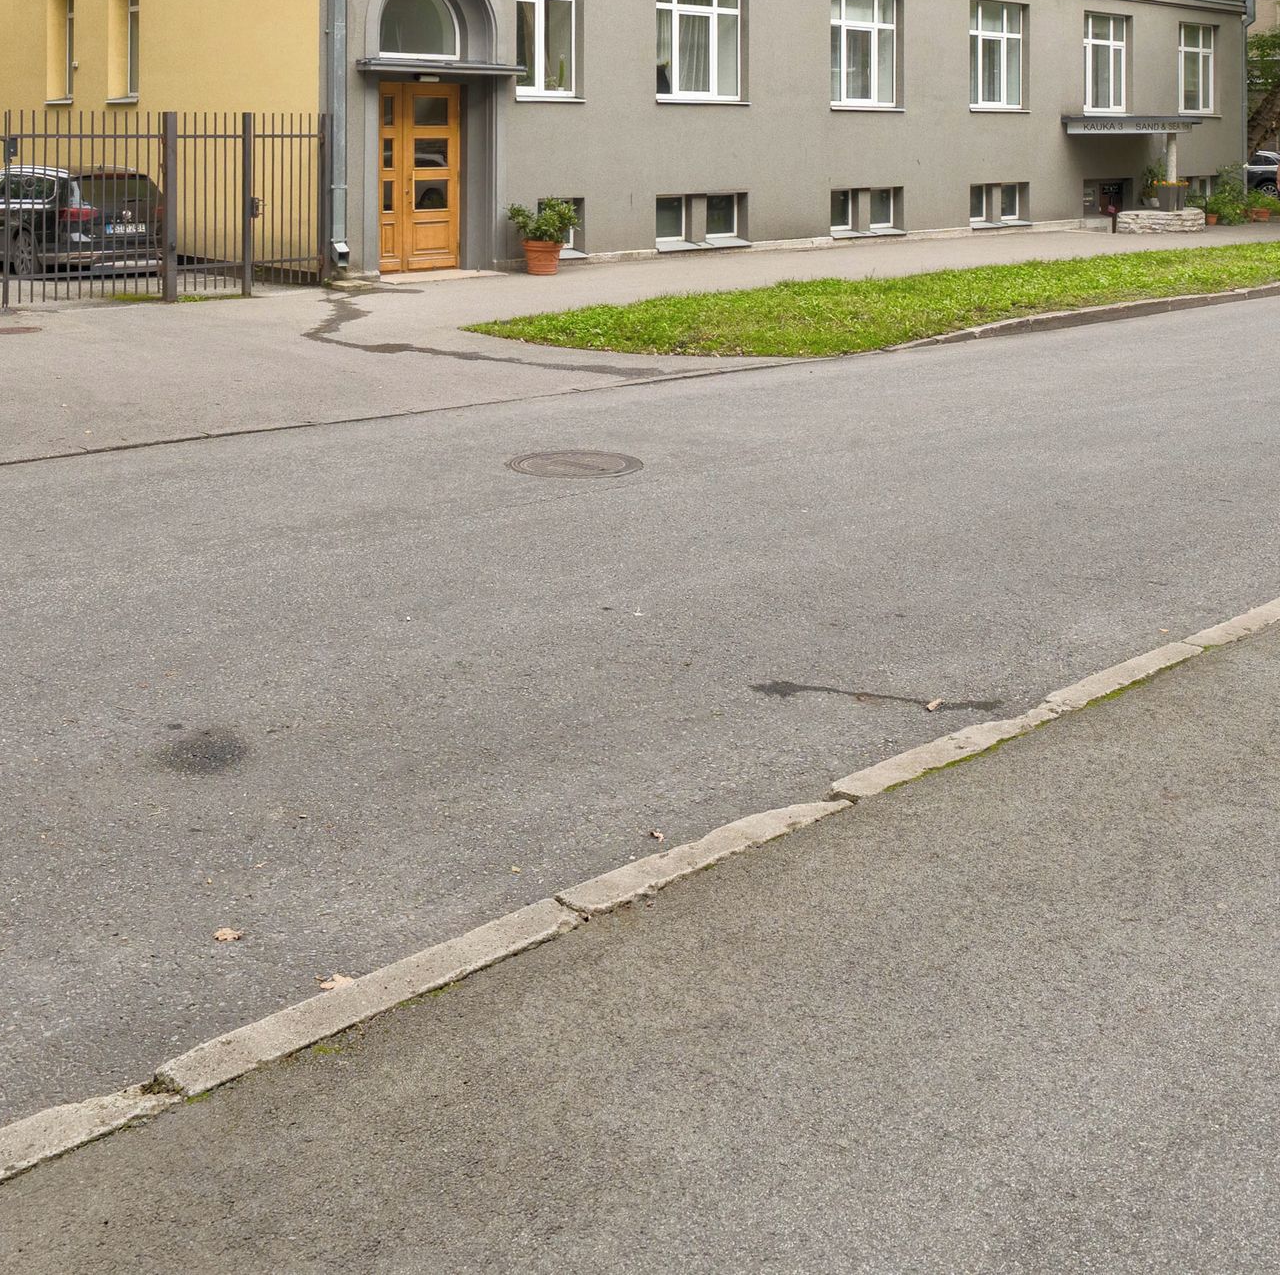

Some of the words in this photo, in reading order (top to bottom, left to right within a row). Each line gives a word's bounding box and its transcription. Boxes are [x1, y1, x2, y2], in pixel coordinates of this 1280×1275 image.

[1083, 122, 1116, 131] KAUKA
[1118, 122, 1124, 130] 3
[1135, 122, 1159, 131] SAND
[1161, 122, 1167, 131] &
[1168, 122, 1181, 131] SEA
